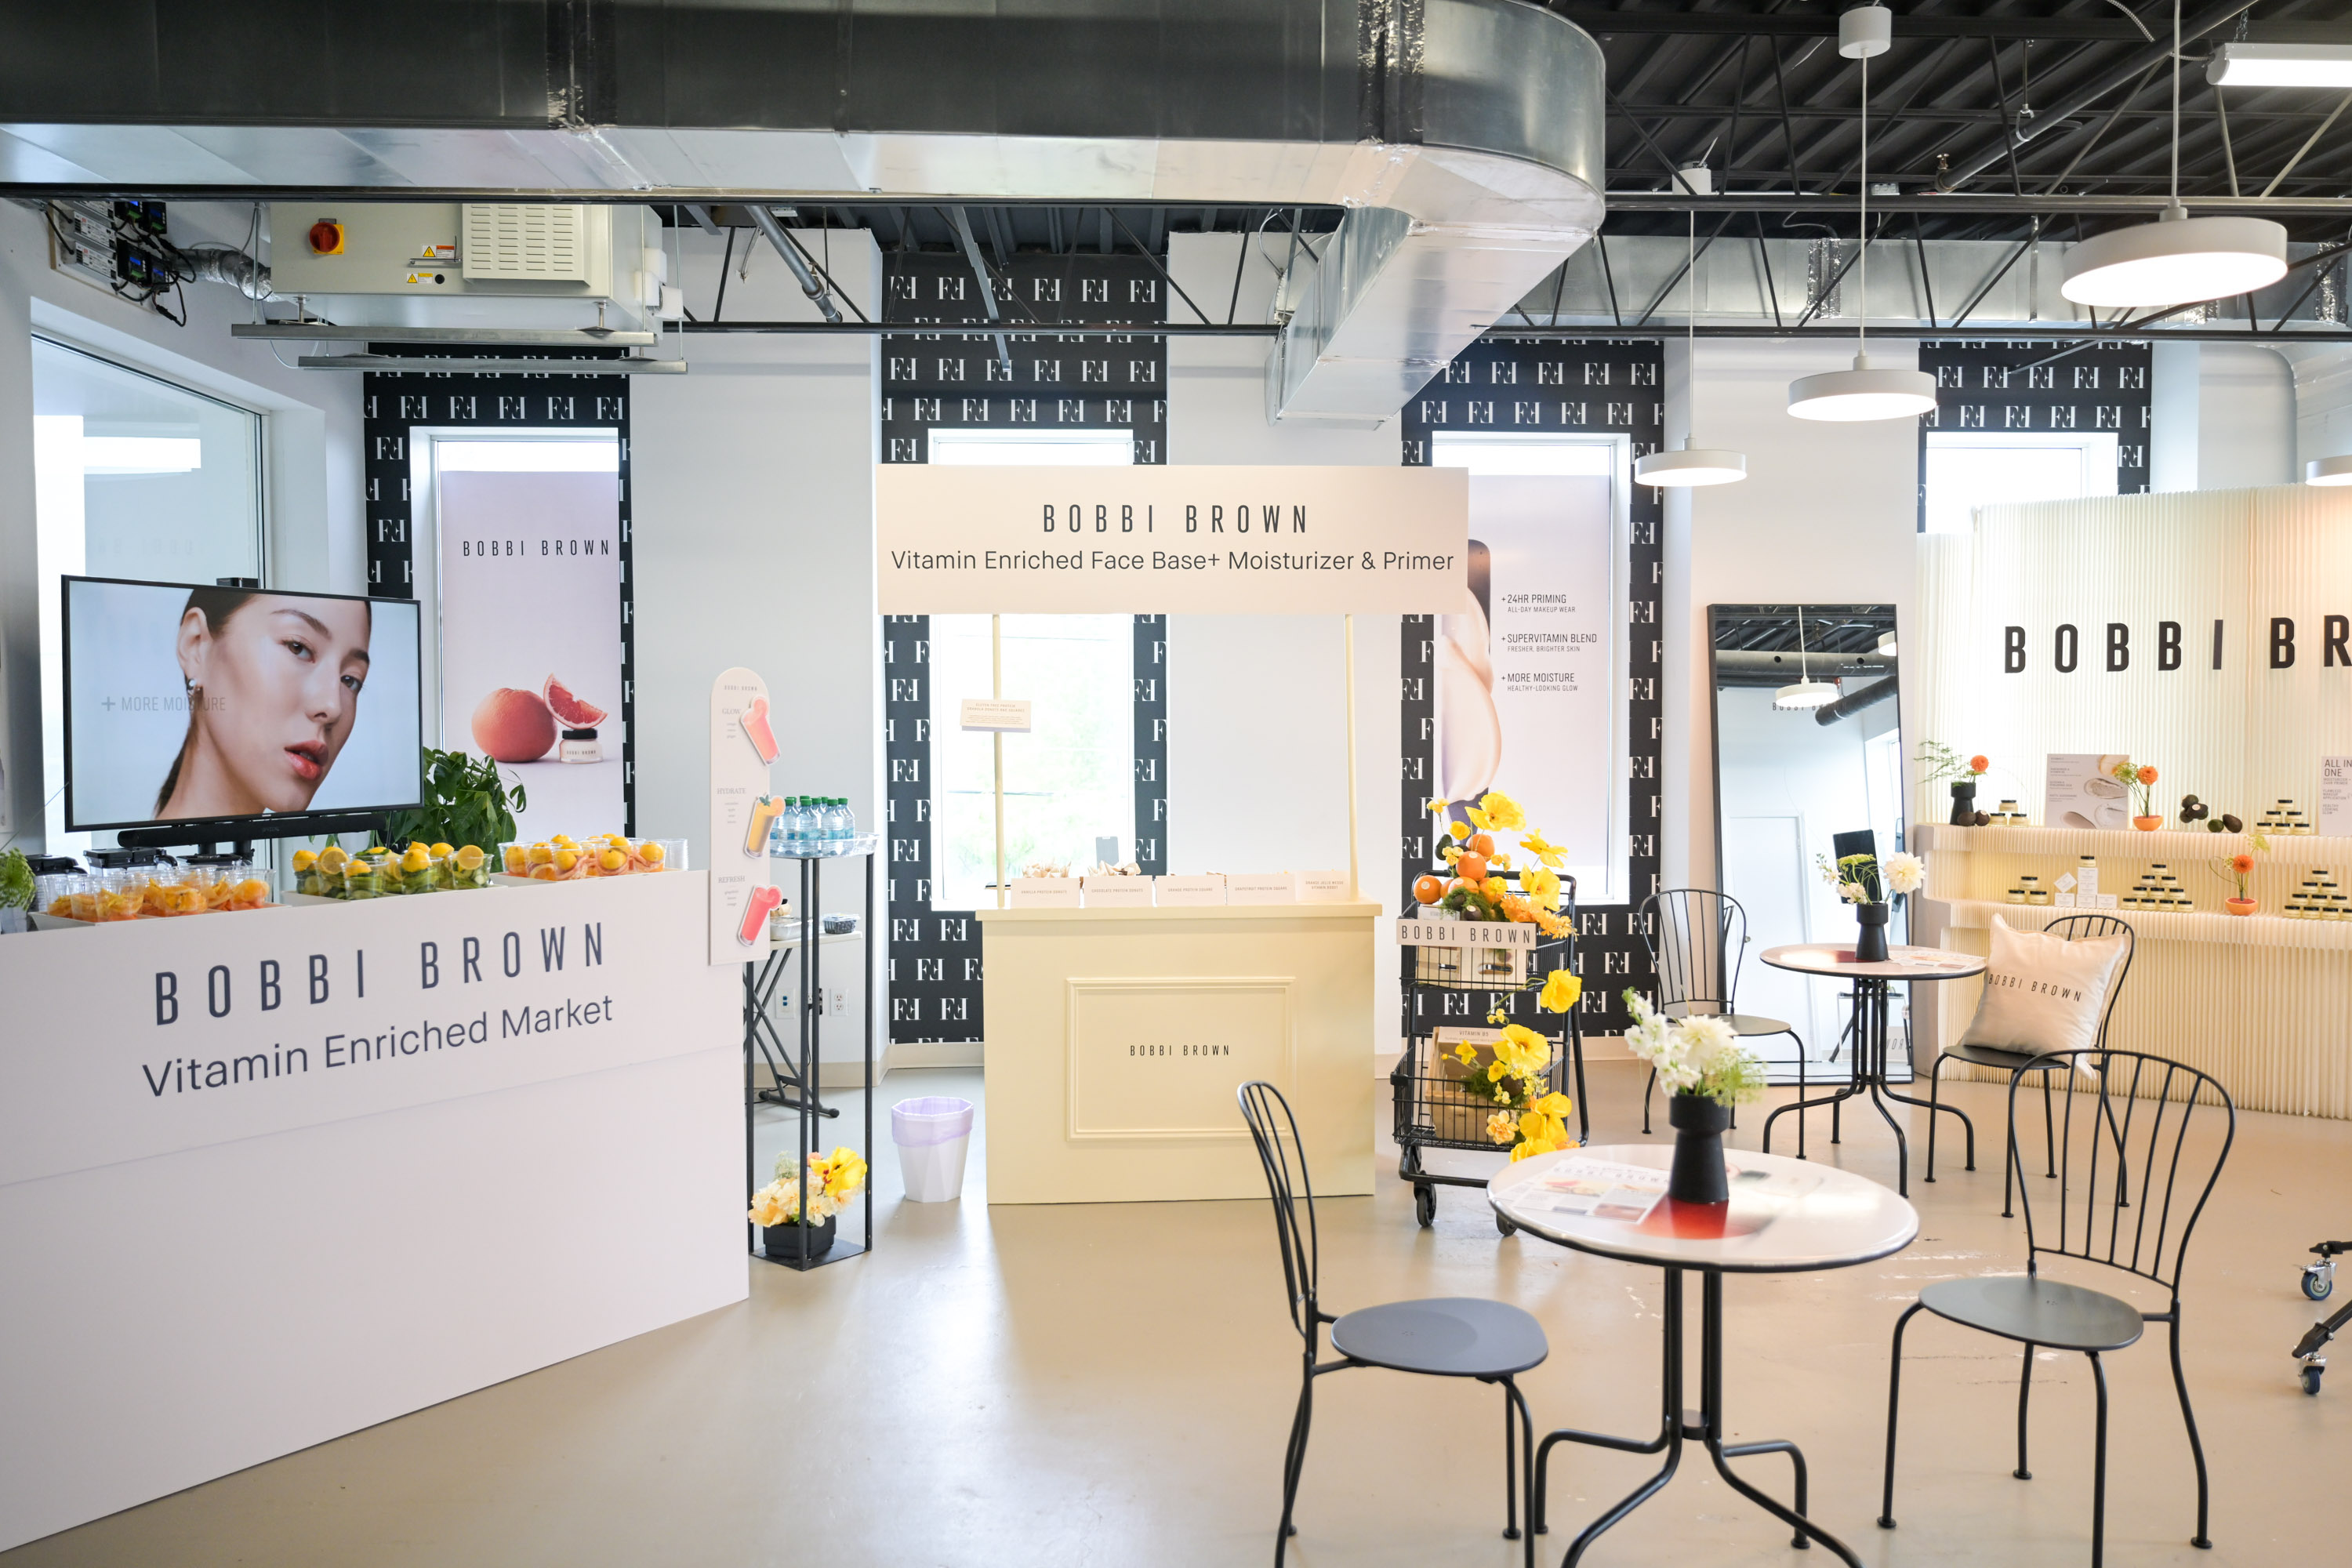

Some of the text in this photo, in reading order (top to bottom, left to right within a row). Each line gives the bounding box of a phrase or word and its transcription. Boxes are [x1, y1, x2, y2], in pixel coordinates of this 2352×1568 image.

[1044, 505, 1305, 533] BOBBI BROWN
[463, 540, 608, 556] BOBBI BROWN
[891, 550, 1454, 569] Vitamin Enriched Face Base+ Moisturizer & Primer
[1532, 594, 1566, 603] PRIMING
[2005, 619, 2223, 673] BOBBI
[1508, 673, 1530, 682] MORE
[1534, 673, 1574, 682] MOISTURE
[122, 696, 159, 712] MORE
[2325, 768, 2342, 777] ONE
[1402, 926, 1529, 943] BOBBI BROWN
[156, 923, 601, 1025] BOBBI BROWN
[1989, 974, 2082, 1003] BOBBI BROWN
[143, 996, 612, 1096] Vitamin Enriched Market
[1131, 1045, 1228, 1055] BOBBI BROWN
